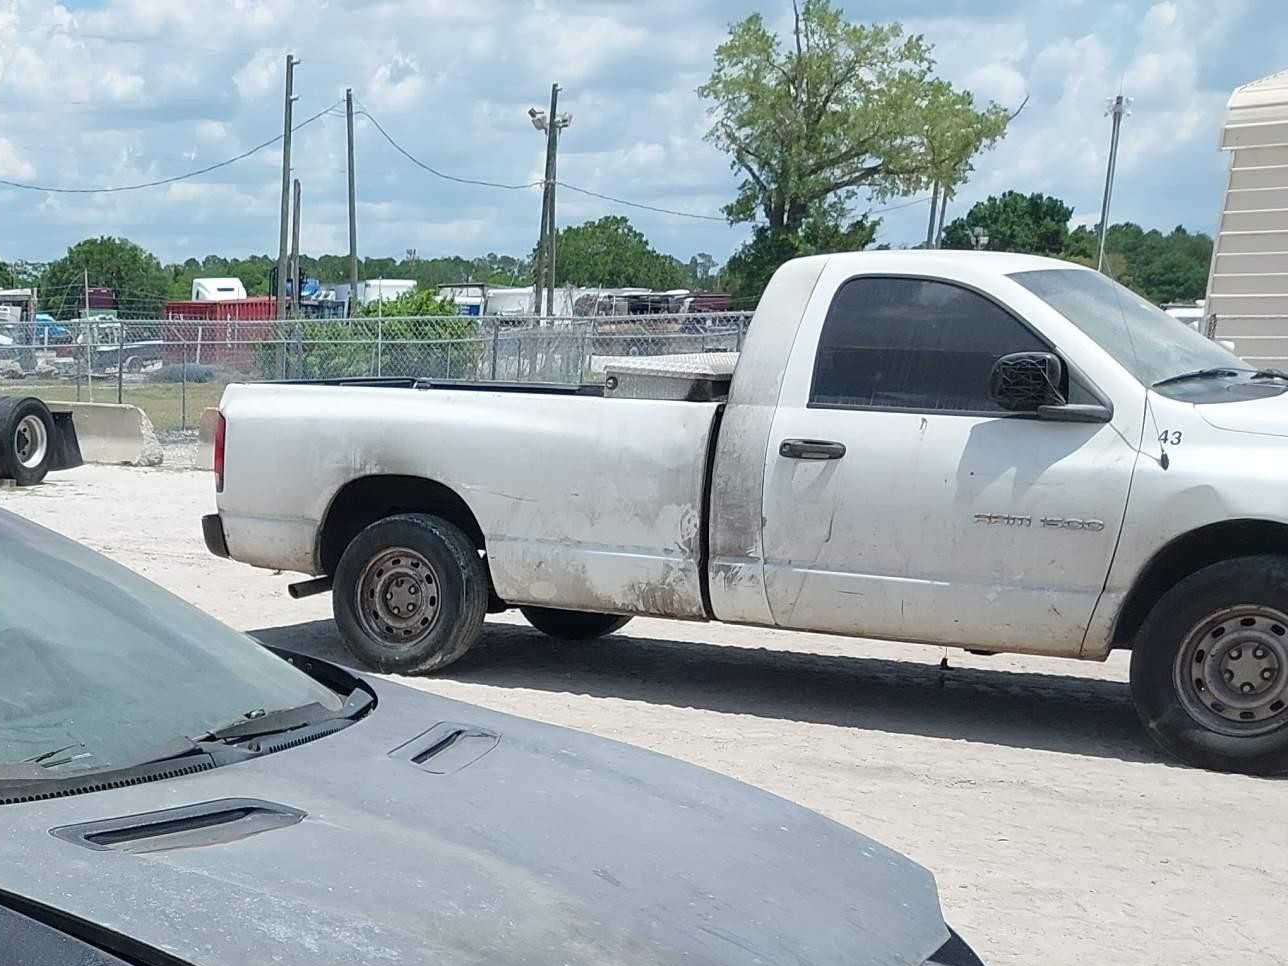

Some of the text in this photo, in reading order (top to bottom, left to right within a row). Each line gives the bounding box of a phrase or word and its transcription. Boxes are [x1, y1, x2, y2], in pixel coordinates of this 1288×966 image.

[1158, 429, 1183, 446] 43
[973, 512, 1105, 532] RAM 1500
